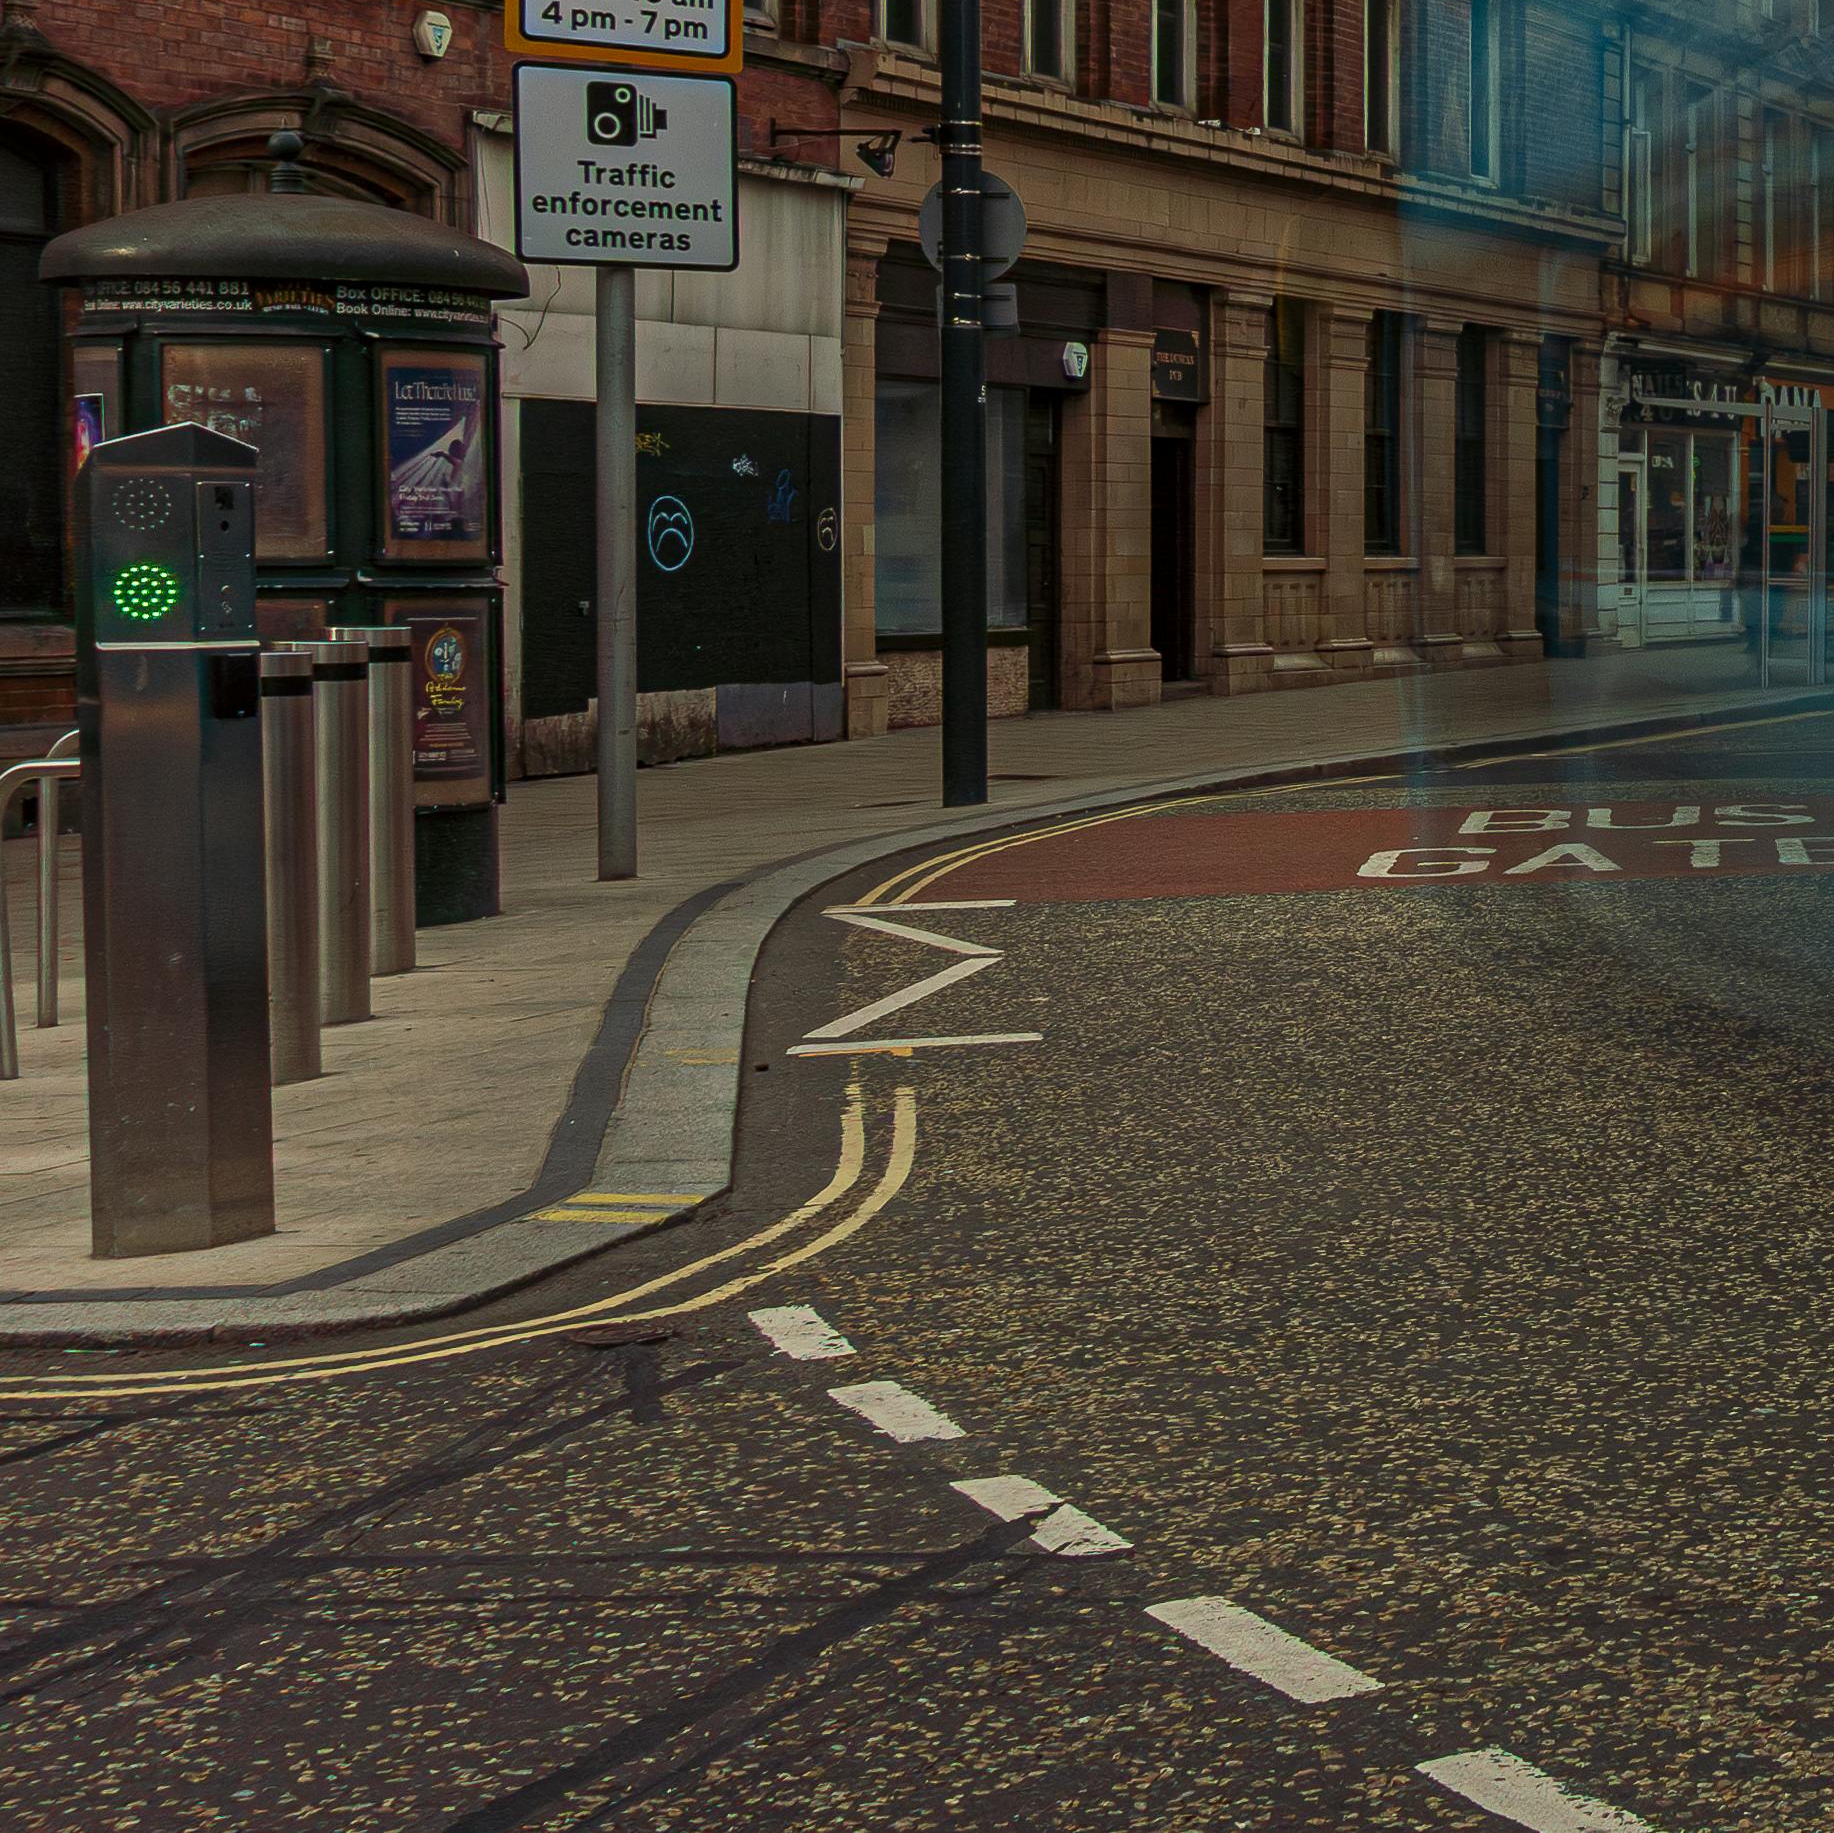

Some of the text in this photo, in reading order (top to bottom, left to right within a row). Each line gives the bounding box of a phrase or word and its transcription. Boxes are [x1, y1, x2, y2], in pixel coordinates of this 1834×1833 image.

[541, 1, 563, 24] 4
[570, 8, 616, 31] pm
[640, 11, 658, 33] 7
[664, 17, 708, 40] pm
[577, 160, 676, 189] Traffic
[532, 191, 722, 222] enforcement
[565, 228, 691, 251] cameras
[336, 285, 366, 300] Box
[371, 287, 424, 303] OFFICE:
[336, 303, 369, 315] Book
[373, 304, 412, 317] Online:
[1459, 804, 1816, 835] BUS
